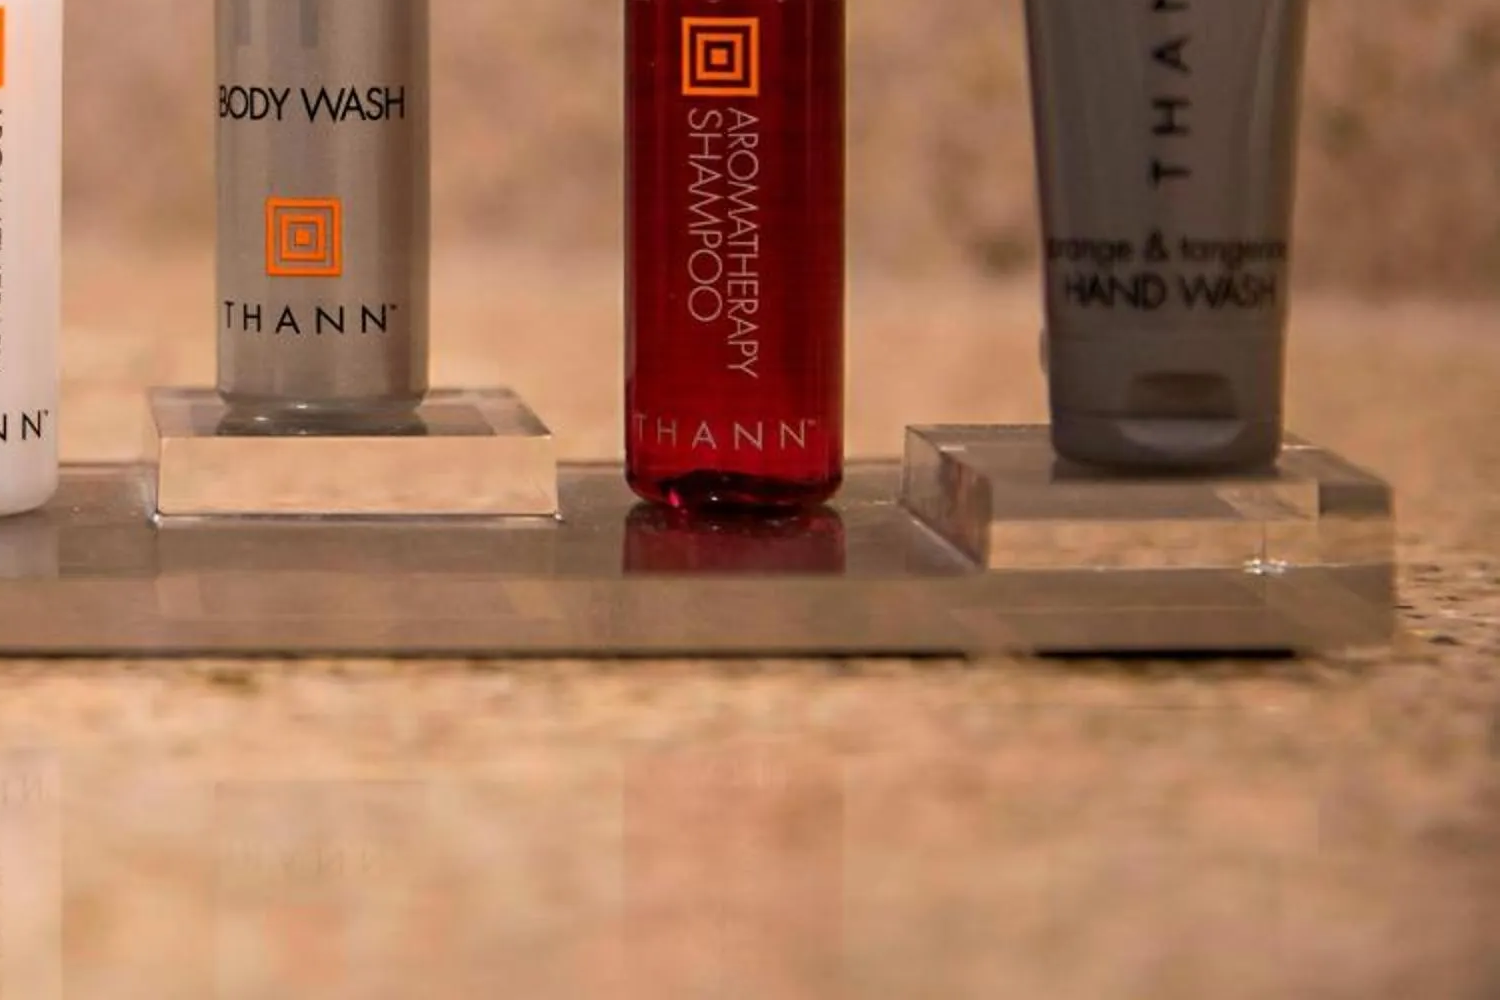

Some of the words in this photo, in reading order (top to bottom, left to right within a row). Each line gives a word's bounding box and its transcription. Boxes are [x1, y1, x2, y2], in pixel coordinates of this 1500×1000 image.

[219, 84, 291, 122] BODY
[300, 84, 405, 124] WASH
[687, 107, 724, 323] SHAMPOO
[726, 106, 760, 379] AROMATHERAPY
[1144, 228, 1170, 262] &
[1064, 271, 1167, 311] HAND
[1179, 272, 1278, 309] WASH
[224, 301, 387, 335] THANN
[632, 413, 806, 452] THANN
